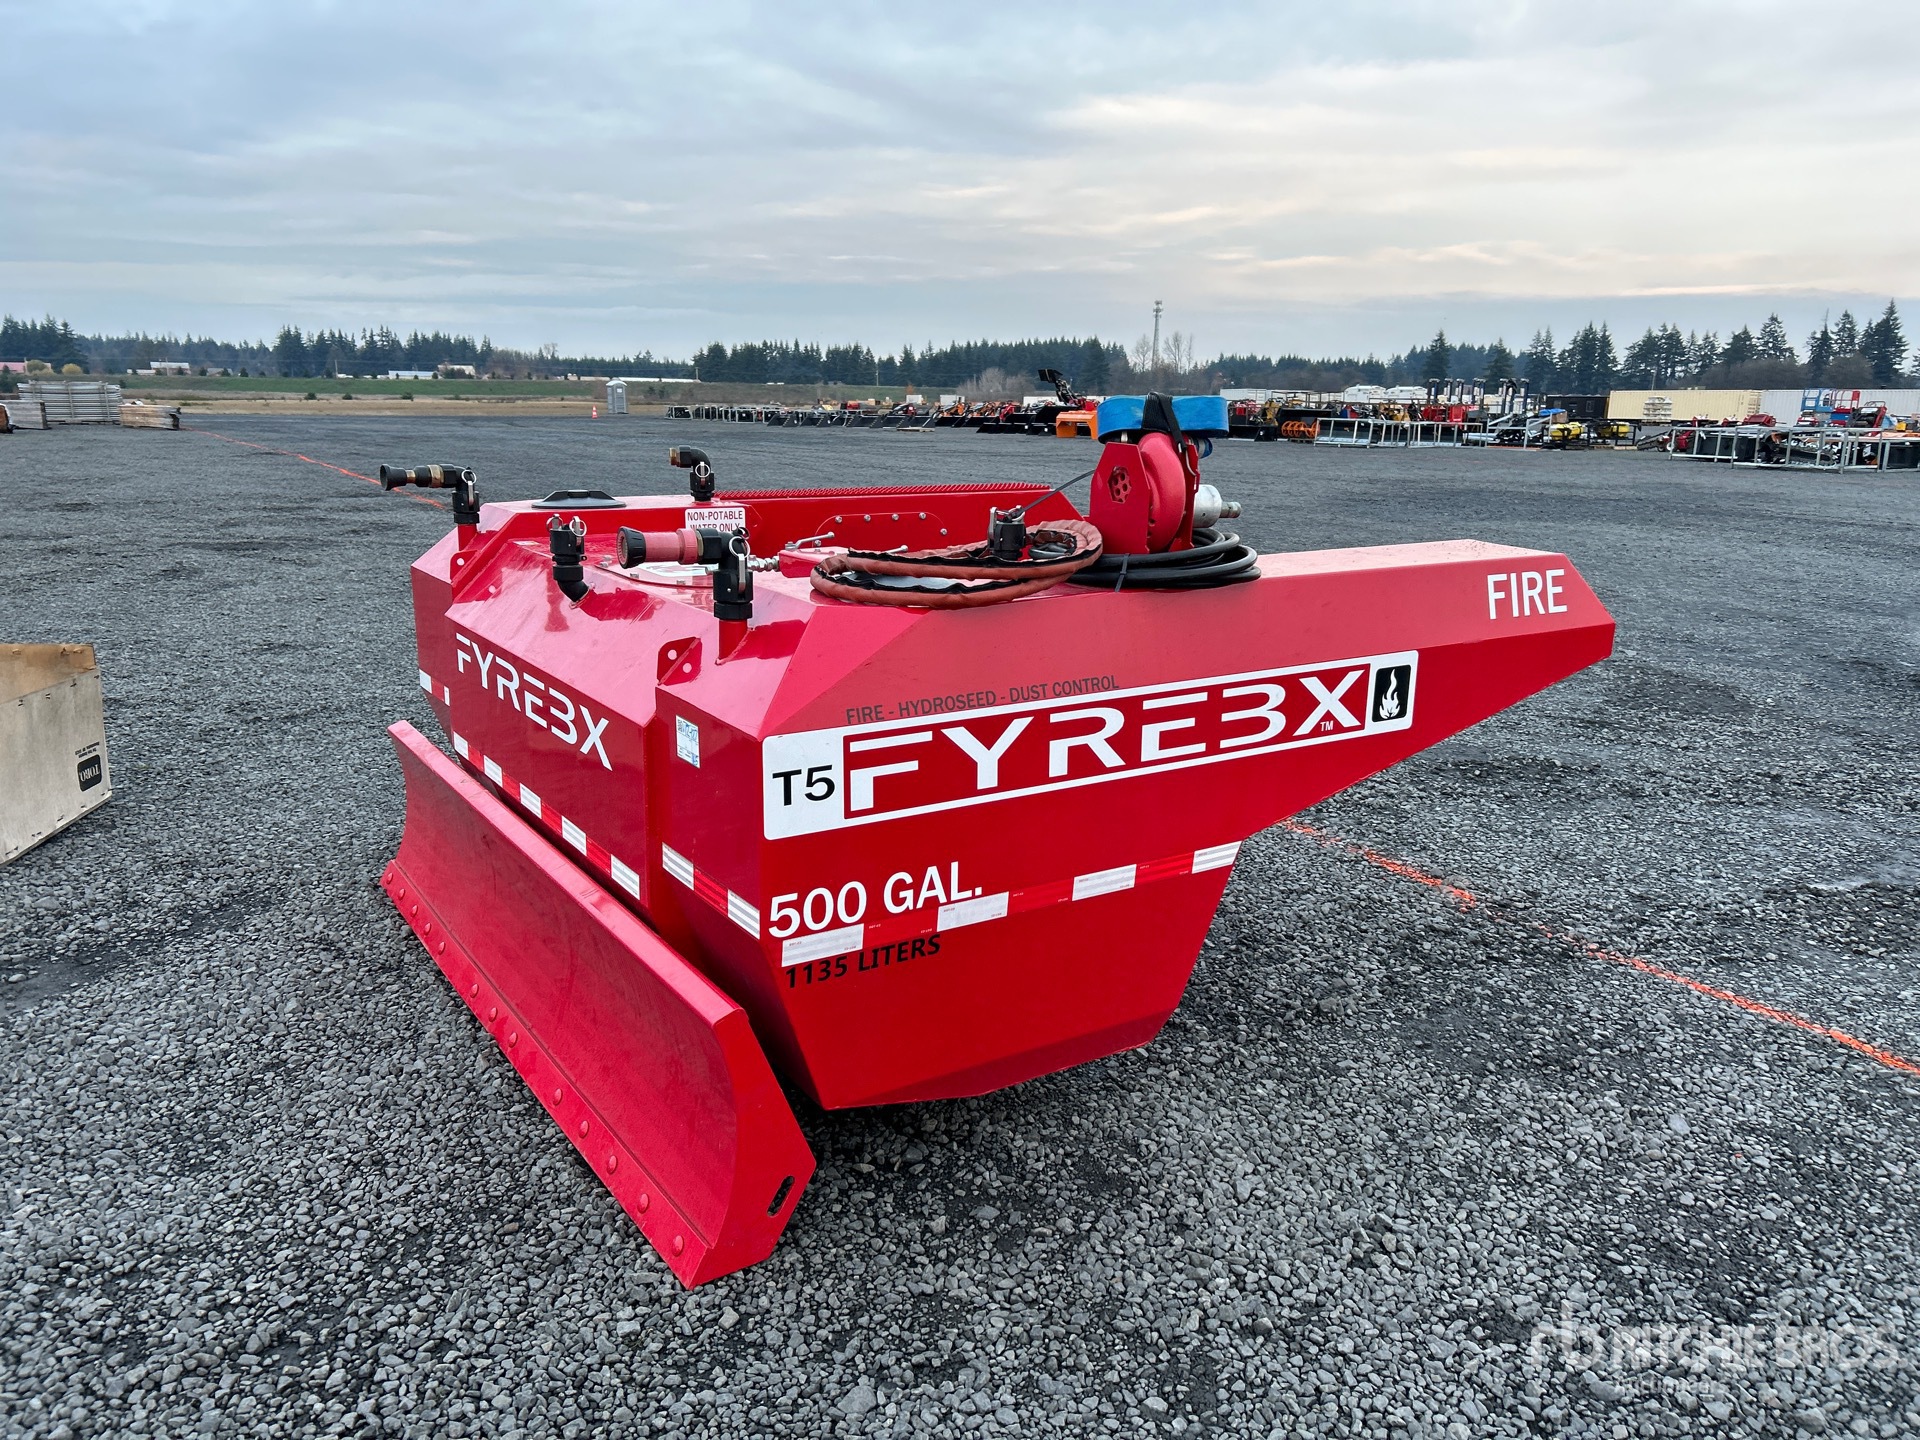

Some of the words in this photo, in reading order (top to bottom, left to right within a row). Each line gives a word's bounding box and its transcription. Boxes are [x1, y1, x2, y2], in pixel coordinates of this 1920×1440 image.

[687, 510, 743, 521] NON-POTABLE
[1486, 568, 1568, 620] FIRE
[456, 632, 613, 770] FYREBX
[846, 705, 885, 725] FIRE
[899, 690, 997, 718] HYDROSEED
[1009, 683, 1049, 703] DUST
[1052, 674, 1120, 698] CONTROL
[772, 764, 836, 806] T5
[850, 669, 1365, 811] FYREBX
[1320, 720, 1334, 732] TM
[768, 880, 867, 939] 500
[882, 861, 983, 914] GAL.
[785, 955, 849, 988] 1135
[858, 934, 941, 973] LITERS
